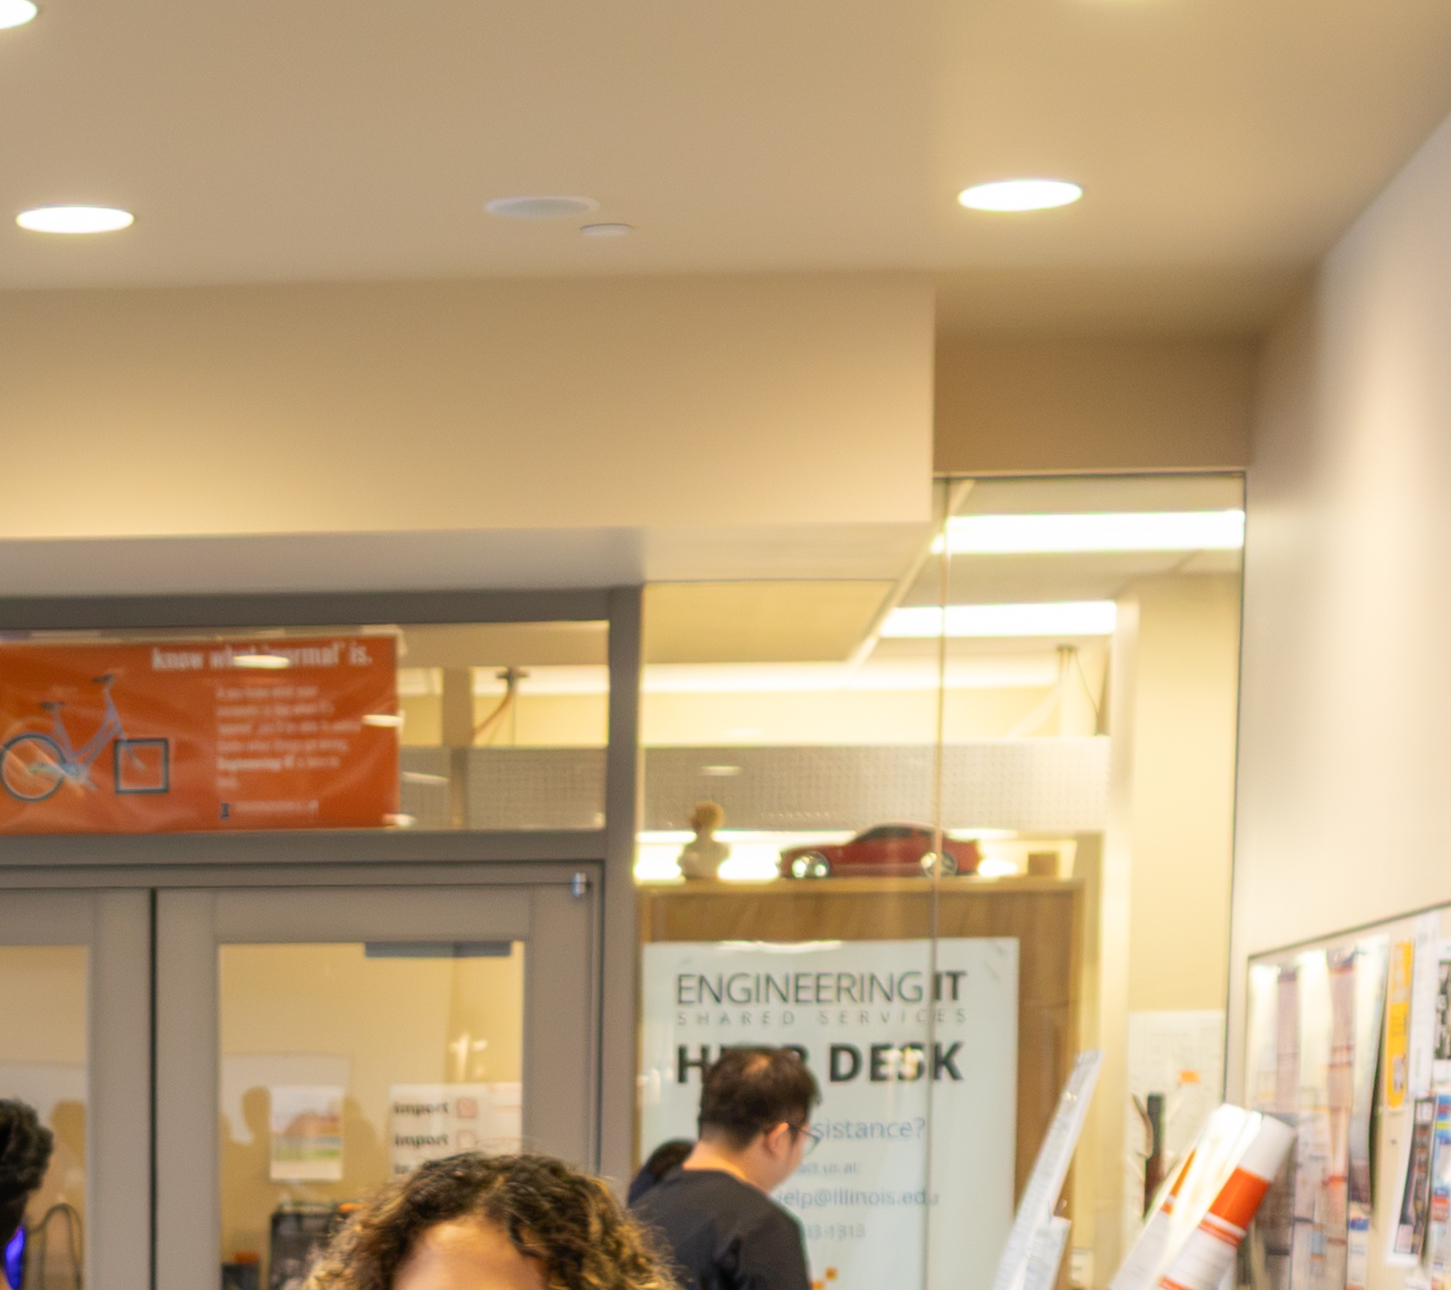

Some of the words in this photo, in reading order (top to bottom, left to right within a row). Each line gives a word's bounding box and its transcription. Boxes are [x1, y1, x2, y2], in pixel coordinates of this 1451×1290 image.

[676, 972, 924, 1004] ENGINEERING
[934, 971, 966, 1002] IT
[677, 1009, 796, 1025] SHARED
[819, 1008, 966, 1024] SERVICES
[830, 1042, 965, 1083] DESK
